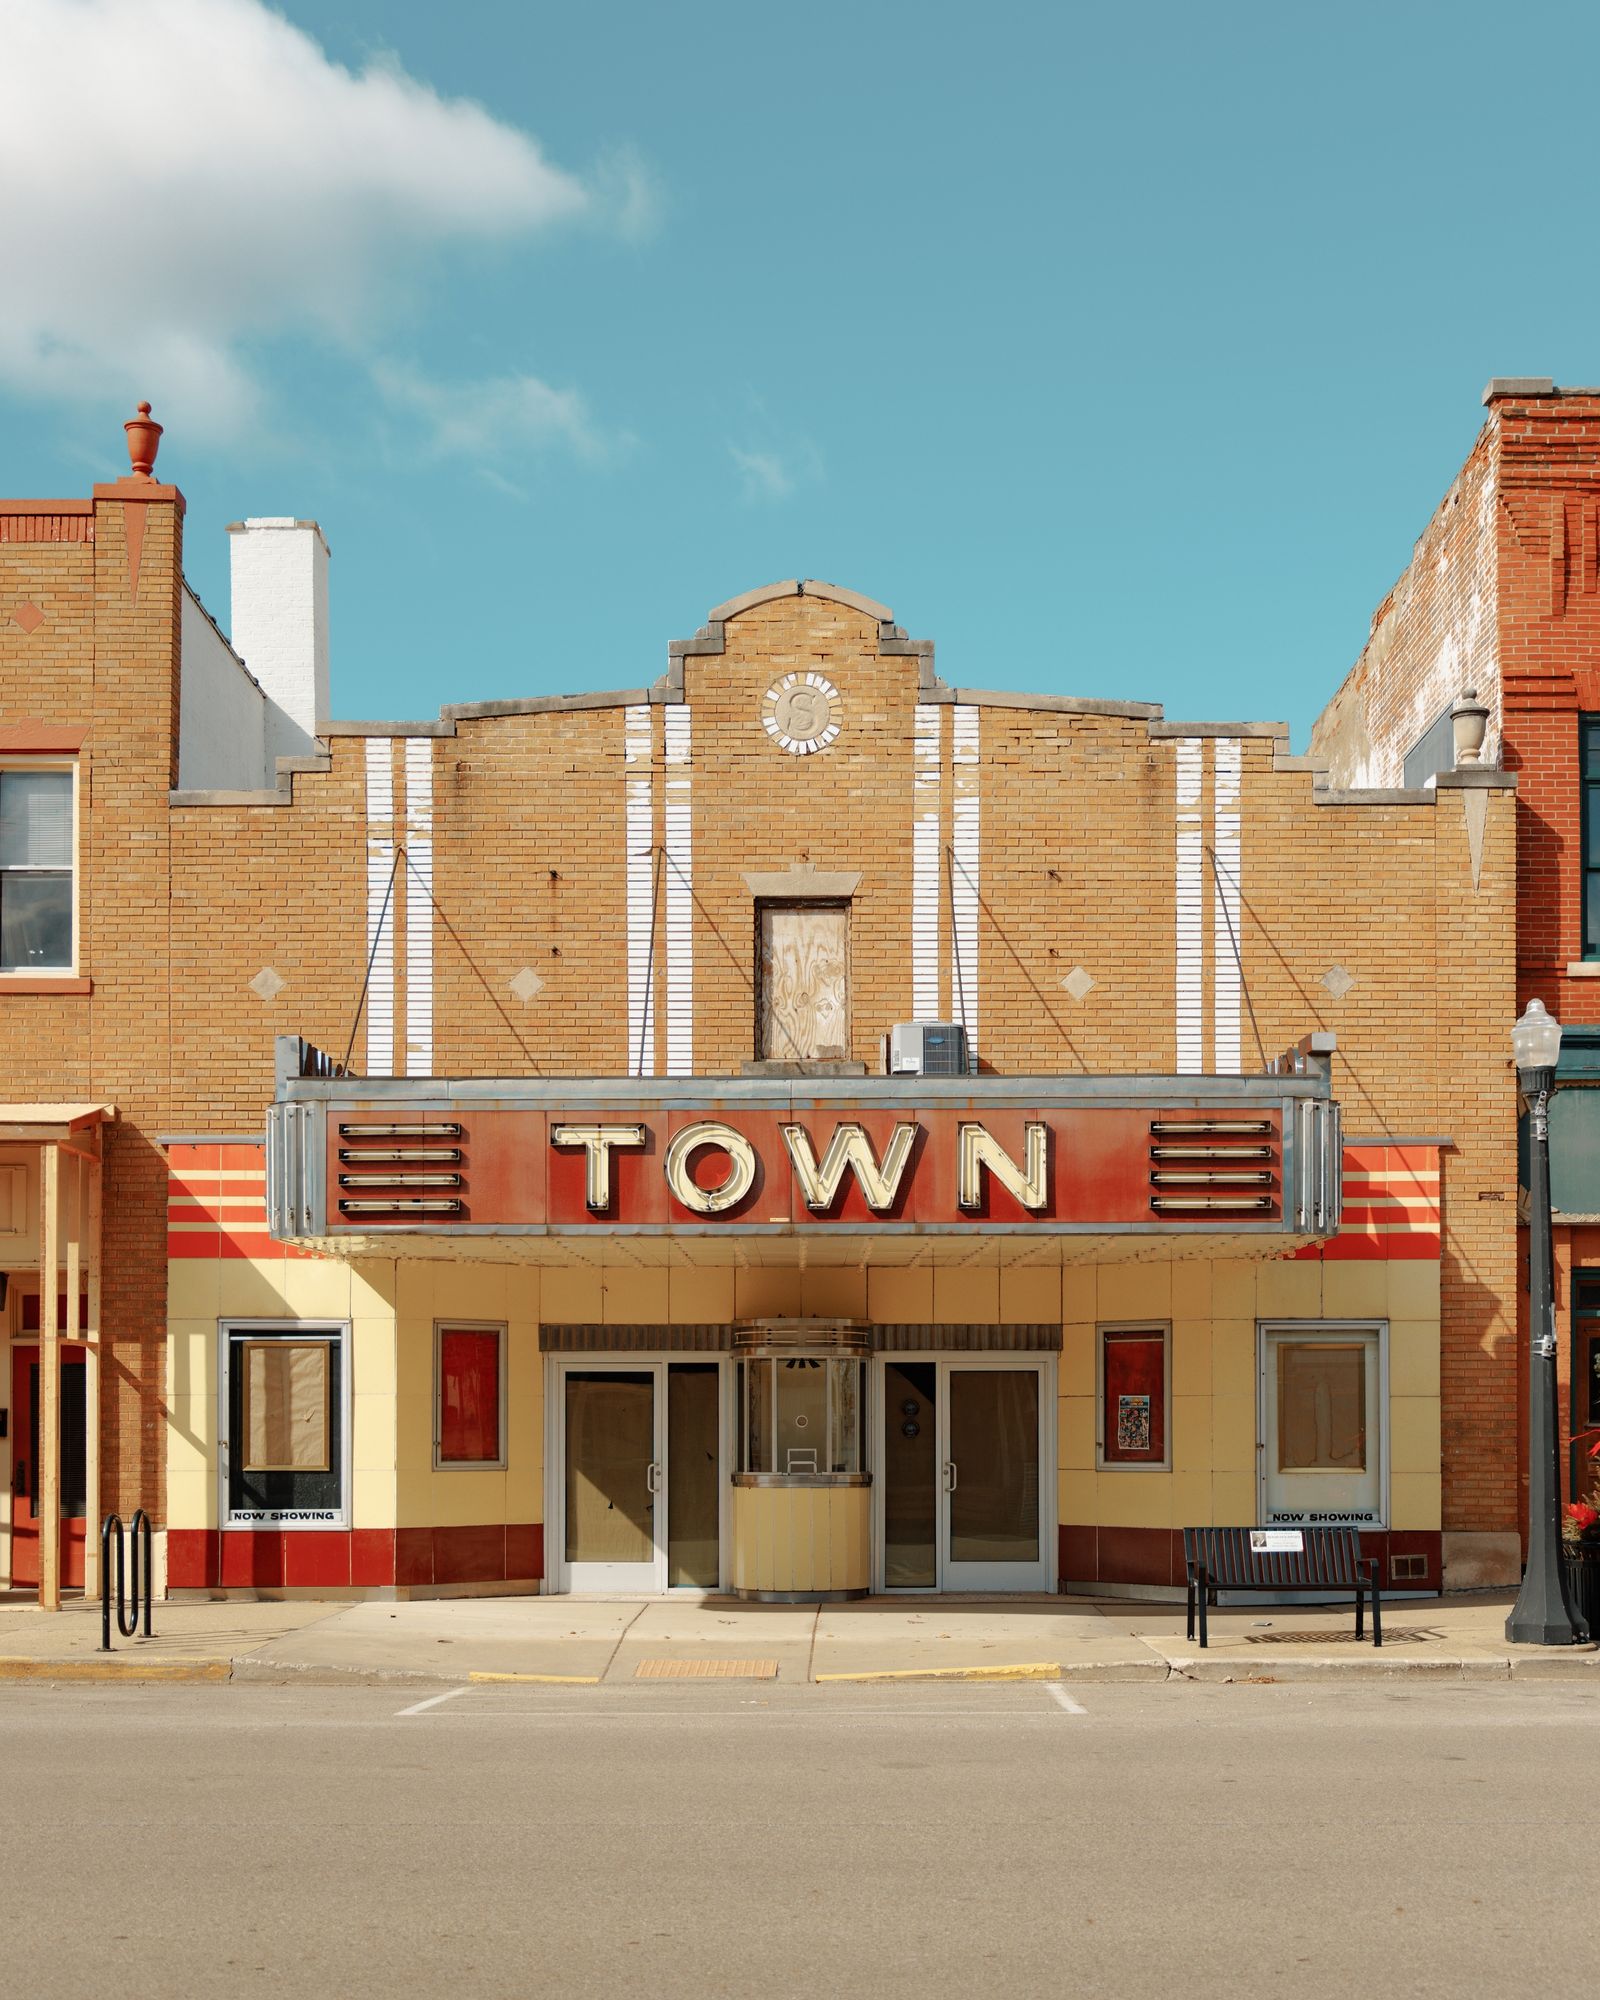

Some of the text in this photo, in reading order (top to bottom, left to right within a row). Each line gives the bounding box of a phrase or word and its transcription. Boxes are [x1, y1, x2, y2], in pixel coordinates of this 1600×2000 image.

[550, 1120, 1048, 1213] TOWN
[234, 1512, 335, 1520] NOW SHOWING
[1272, 1513, 1374, 1521] NOW SHOWING
